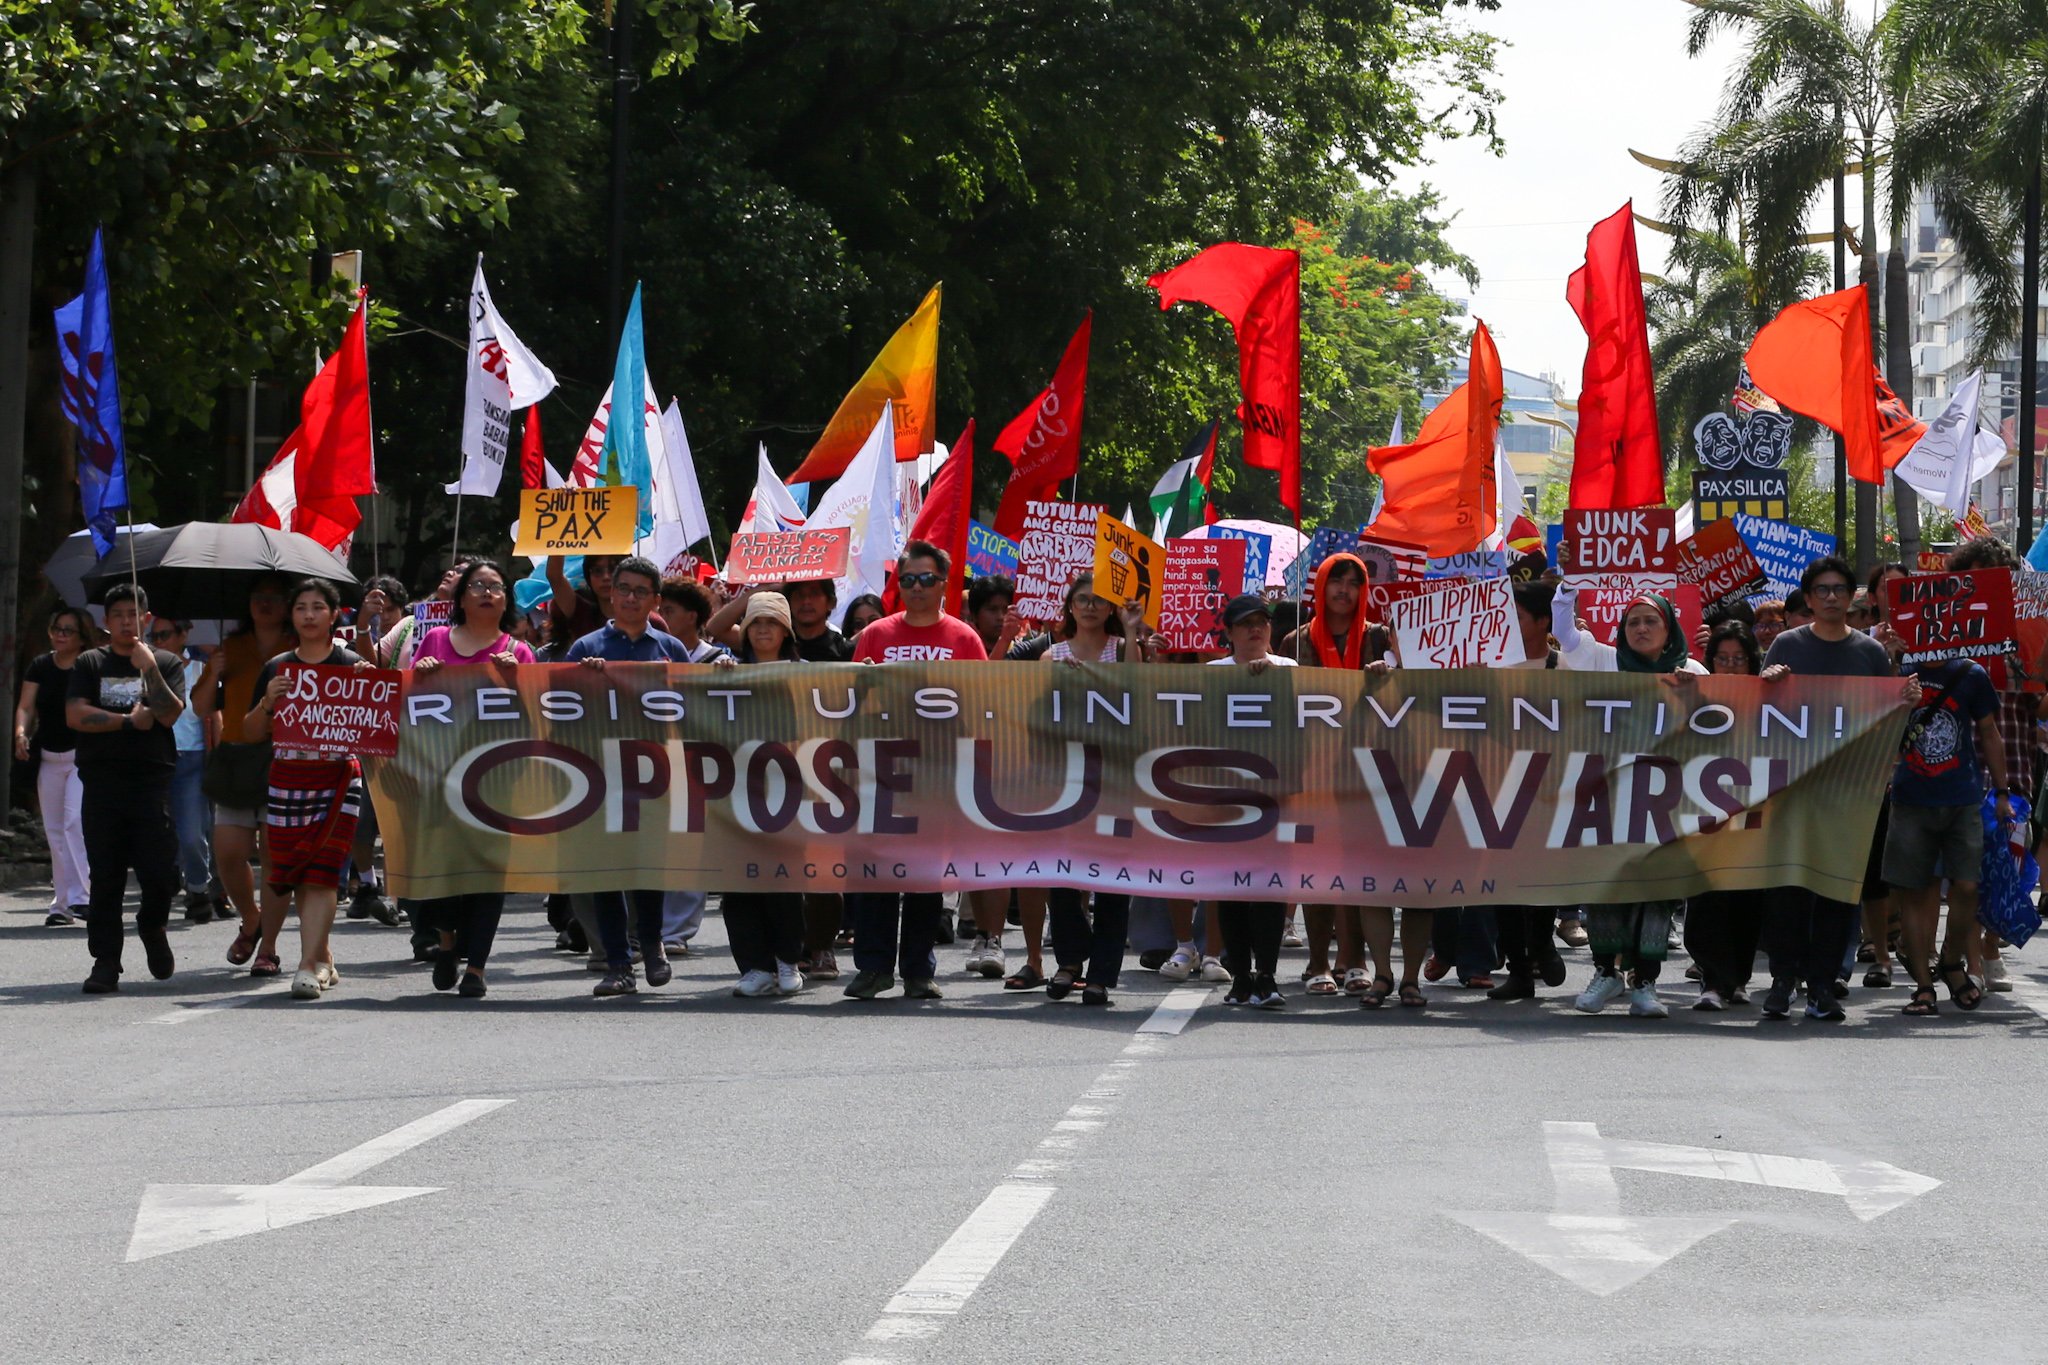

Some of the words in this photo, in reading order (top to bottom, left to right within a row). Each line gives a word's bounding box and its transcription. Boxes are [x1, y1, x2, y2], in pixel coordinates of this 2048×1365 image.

[1700, 480, 1733, 497] PAX
[1734, 479, 1786, 496] SILICA
[535, 491, 576, 513] SHUT
[582, 490, 612, 512] THE
[1025, 500, 1104, 522] TUTULAN
[535, 511, 607, 540] PAX
[1023, 516, 1052, 532] ANG
[1052, 520, 1097, 536] GERAN
[1576, 510, 1649, 536] JUNK
[1735, 512, 1788, 544] YAMAN
[546, 540, 589, 549] DOWN
[968, 526, 1008, 557] STOP
[1007, 545, 1019, 560] TH
[1103, 522, 1135, 555] Junk
[1166, 541, 1196, 557] Lupa
[1203, 544, 1218, 554] sa
[1678, 537, 1743, 585] ORPORATION
[1163, 567, 1188, 580] hindi
[1191, 572, 1204, 581] sa
[1598, 574, 1635, 589] MCPA
[1899, 574, 1977, 603] HANDS
[1160, 592, 1225, 612] REJECT
[1397, 577, 1510, 630] PHILIPPINES
[1922, 599, 1966, 620] OFF
[1159, 611, 1200, 631] PAX
[1418, 619, 1461, 651] NOT
[1468, 609, 1506, 643] FOR
[1915, 616, 1986, 646] IRAN
[1162, 631, 1215, 650] SILICA
[882, 644, 954, 664] SERVE
[1901, 643, 2000, 665] ANAKBAYAN
[324, 676, 370, 701] OUT
[371, 680, 398, 703] OF
[298, 703, 382, 729] ANCESTRAL
[407, 687, 752, 726] RESIST
[811, 686, 994, 720] U.S.
[1052, 689, 1844, 739] INTERVENTION!
[312, 724, 362, 744] LANDS!
[446, 737, 921, 836] OPPOSE
[955, 737, 1314, 844] U.S.
[1352, 746, 1790, 850] WARS!
[745, 862, 908, 881] BAGONG
[943, 857, 1196, 887] ALYANSANG
[1233, 871, 1497, 895] MAKABAYAN
